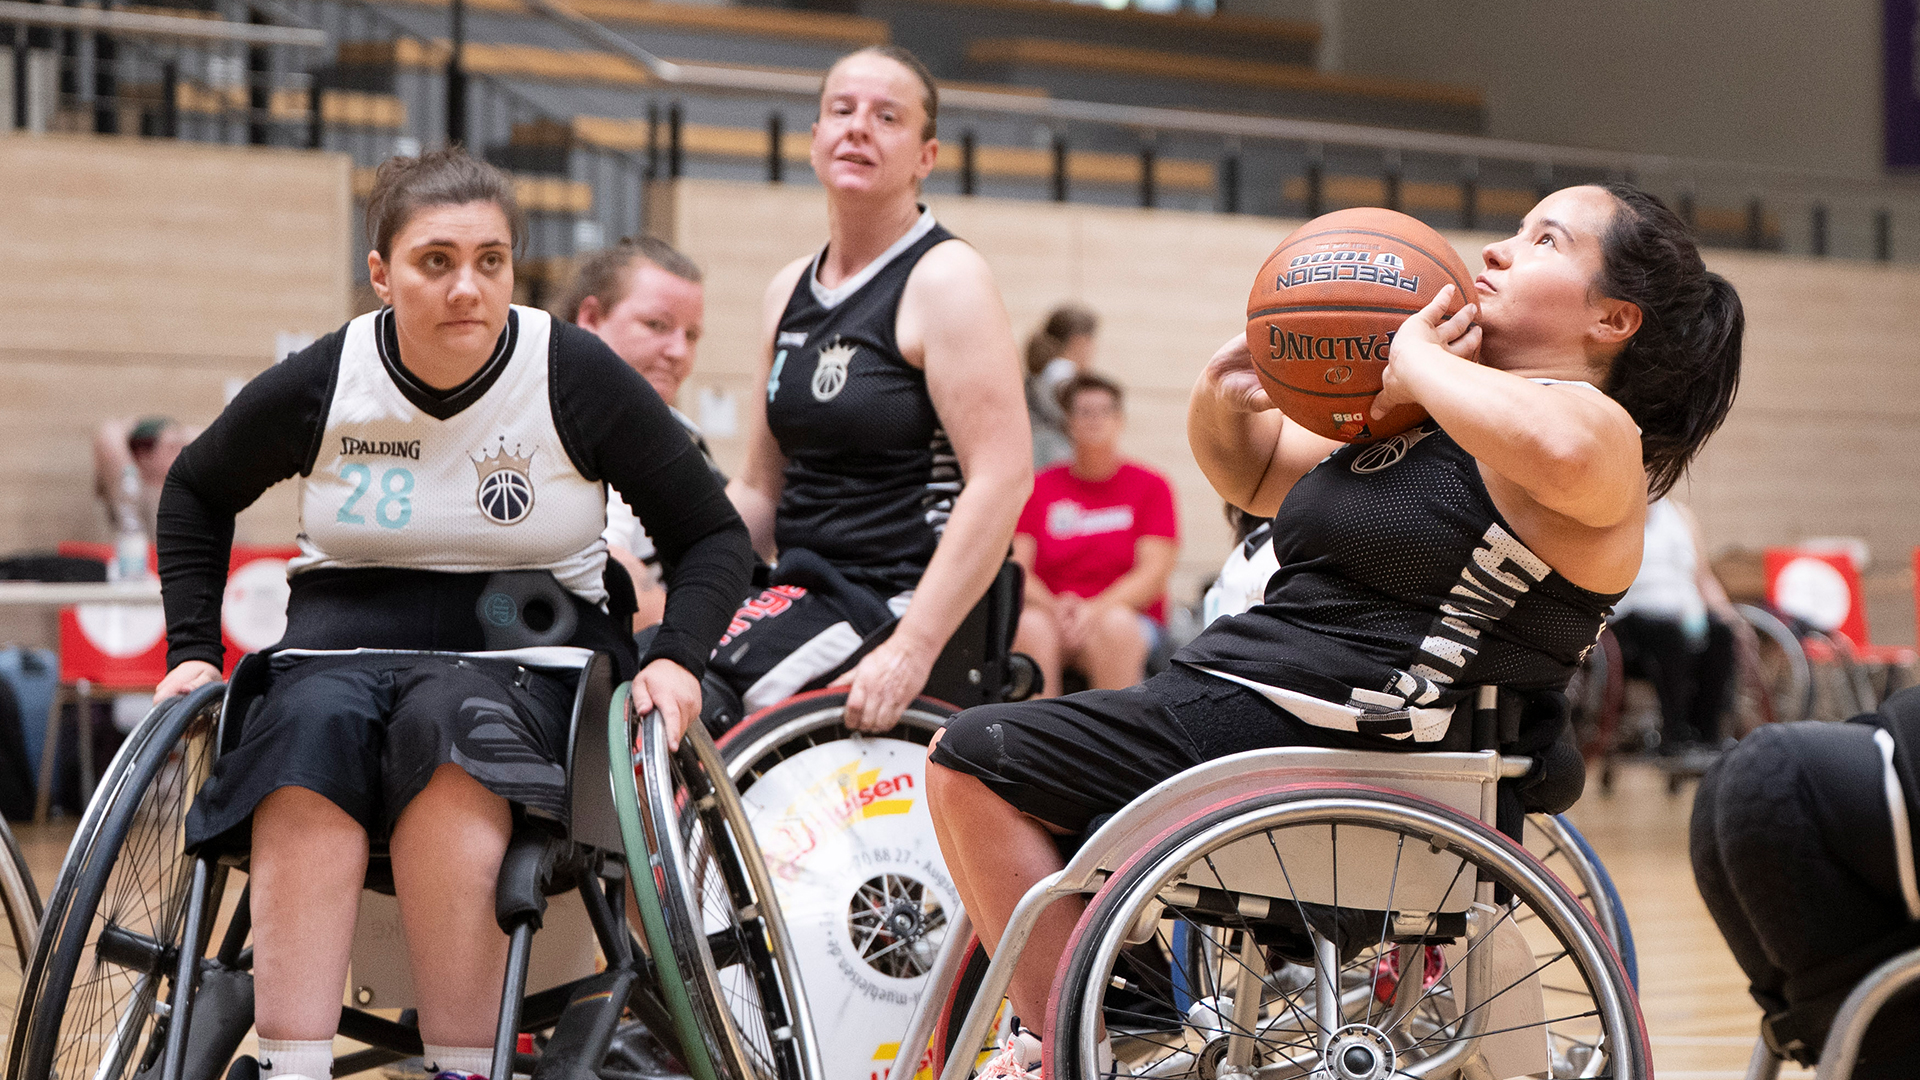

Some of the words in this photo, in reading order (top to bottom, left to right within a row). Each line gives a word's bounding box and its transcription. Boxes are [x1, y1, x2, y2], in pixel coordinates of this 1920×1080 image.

[1289, 251, 1371, 270] 1000
[1275, 264, 1420, 294] PRECISION
[1269, 324, 1397, 362] PALDING
[1332, 412, 1363, 423] DBB
[339, 436, 421, 460] SPALDING
[336, 462, 415, 529] 28
